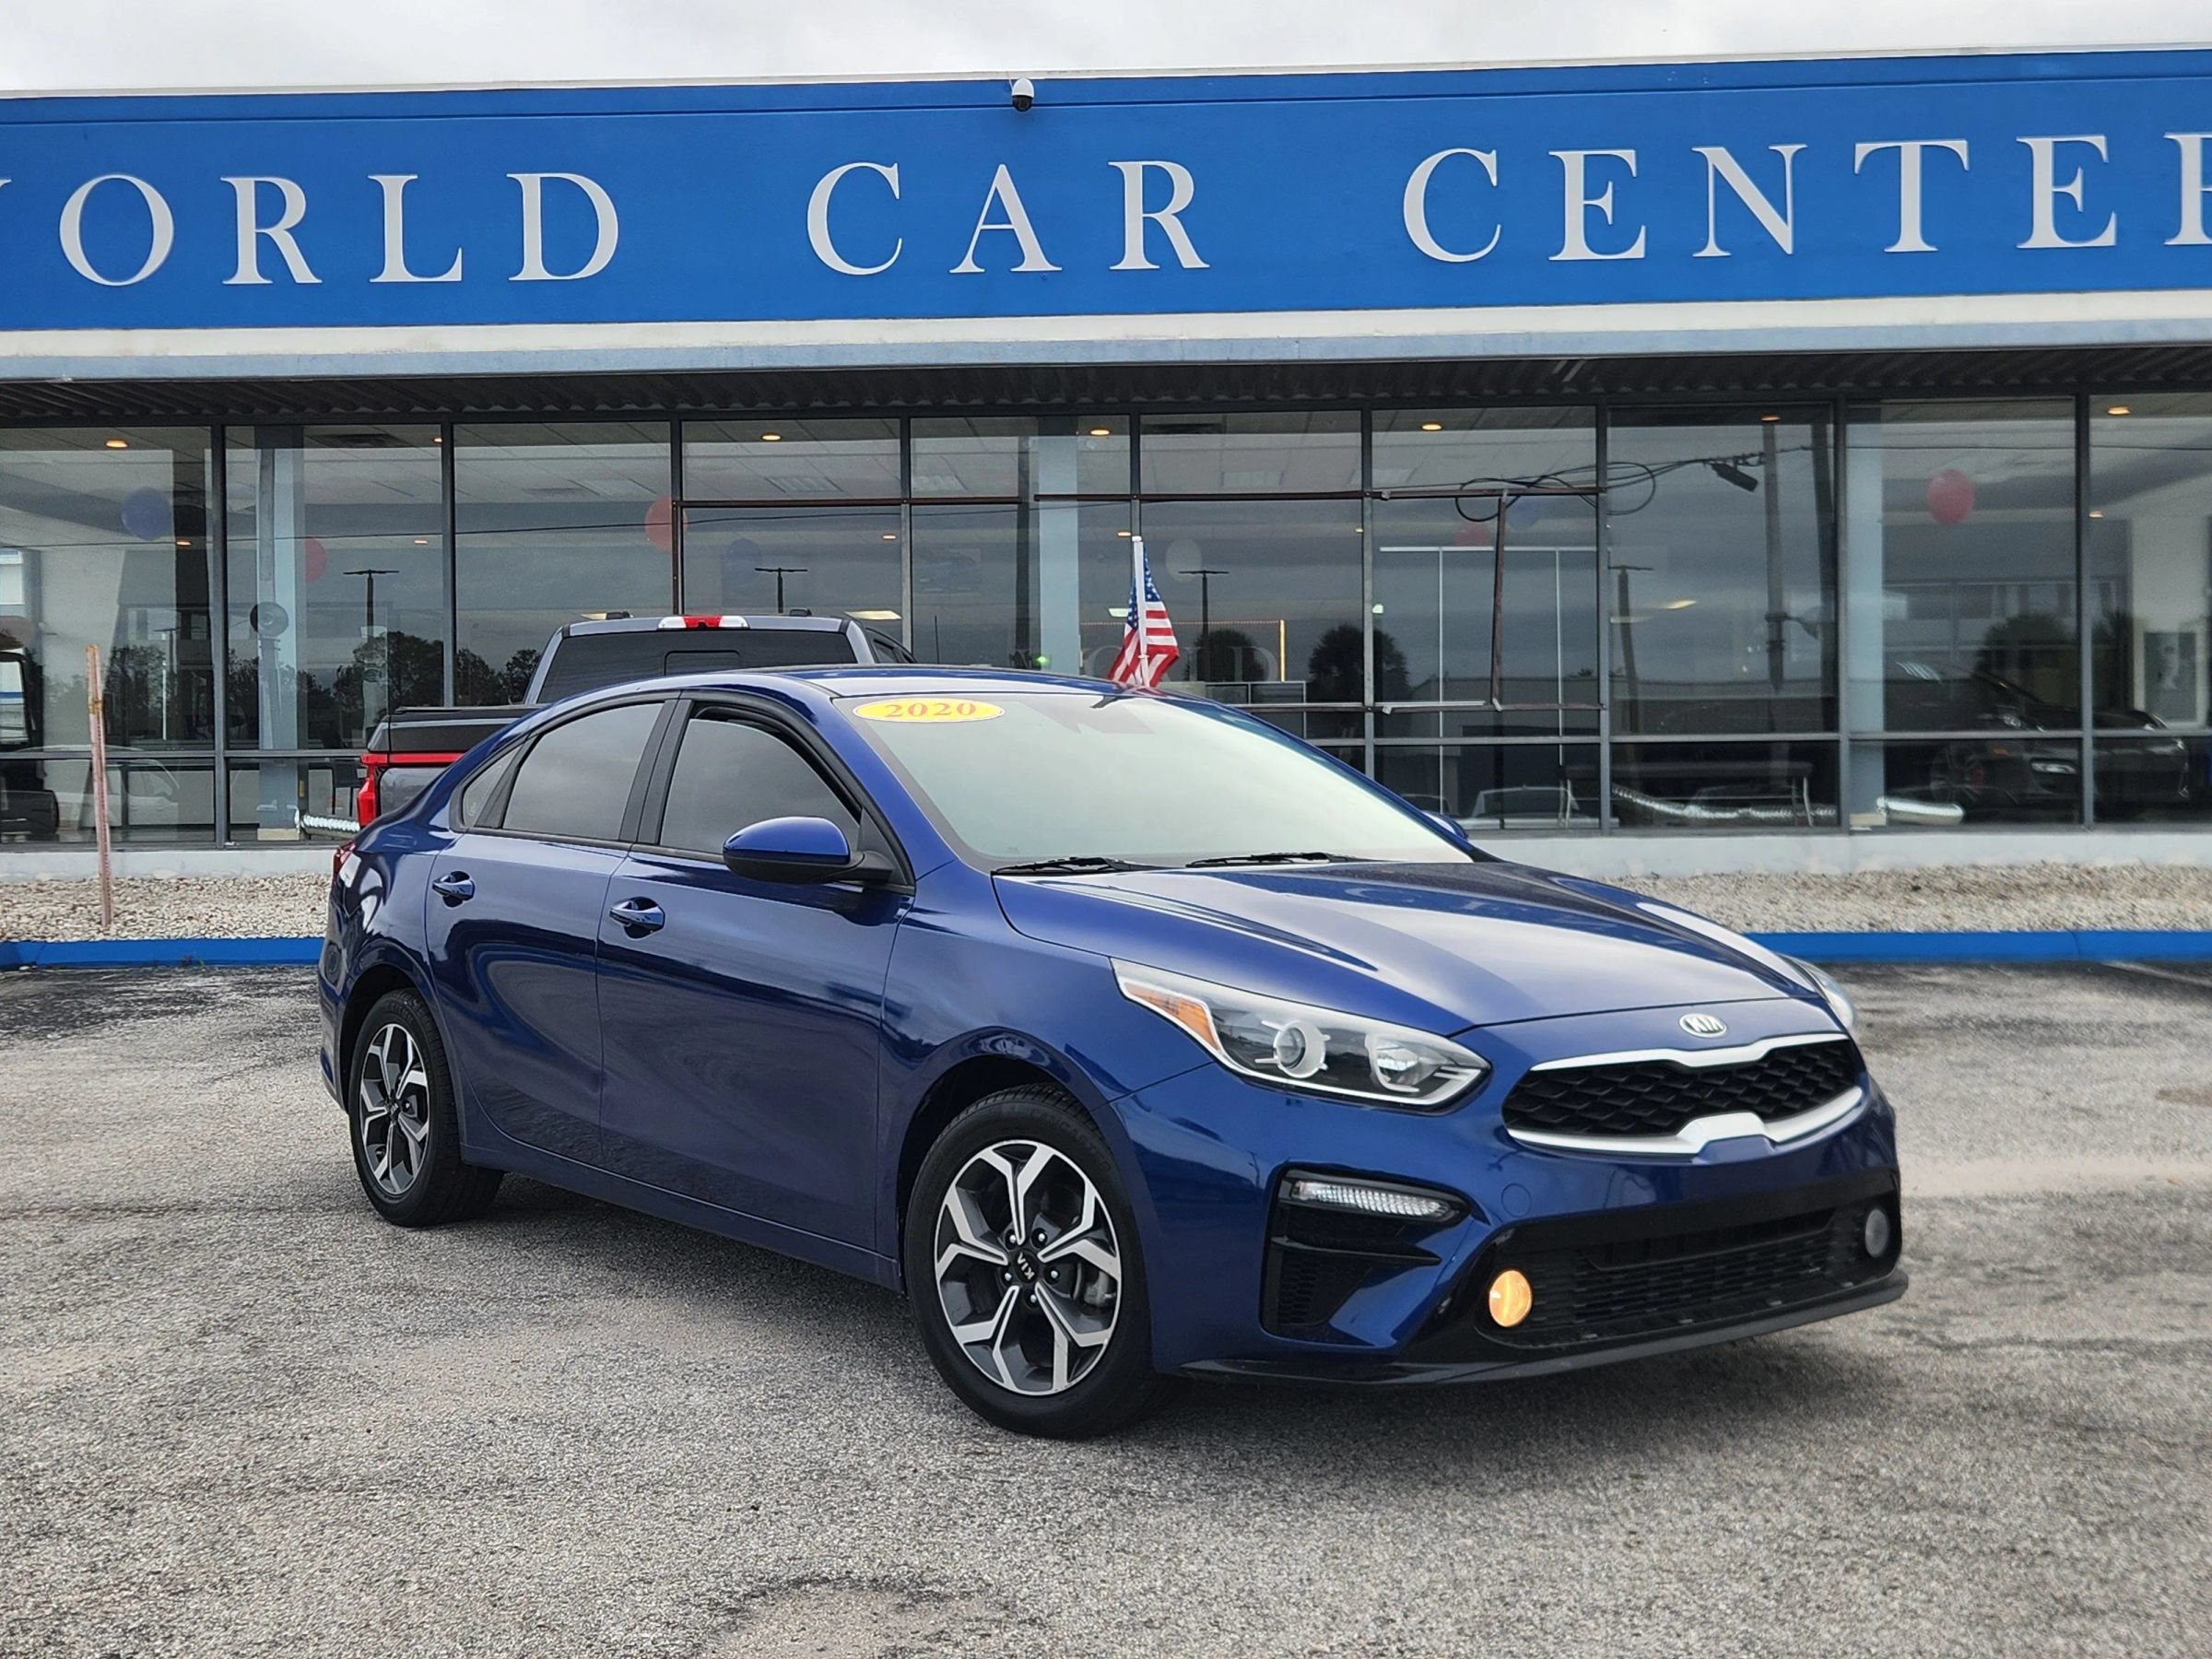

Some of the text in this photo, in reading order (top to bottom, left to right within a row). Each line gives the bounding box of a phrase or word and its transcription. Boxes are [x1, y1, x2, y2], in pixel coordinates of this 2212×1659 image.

[0, 173, 618, 287] ORLD
[806, 160, 1211, 276] CAR
[884, 701, 976, 718] 2020
[1682, 1015, 1725, 1034] KIA
